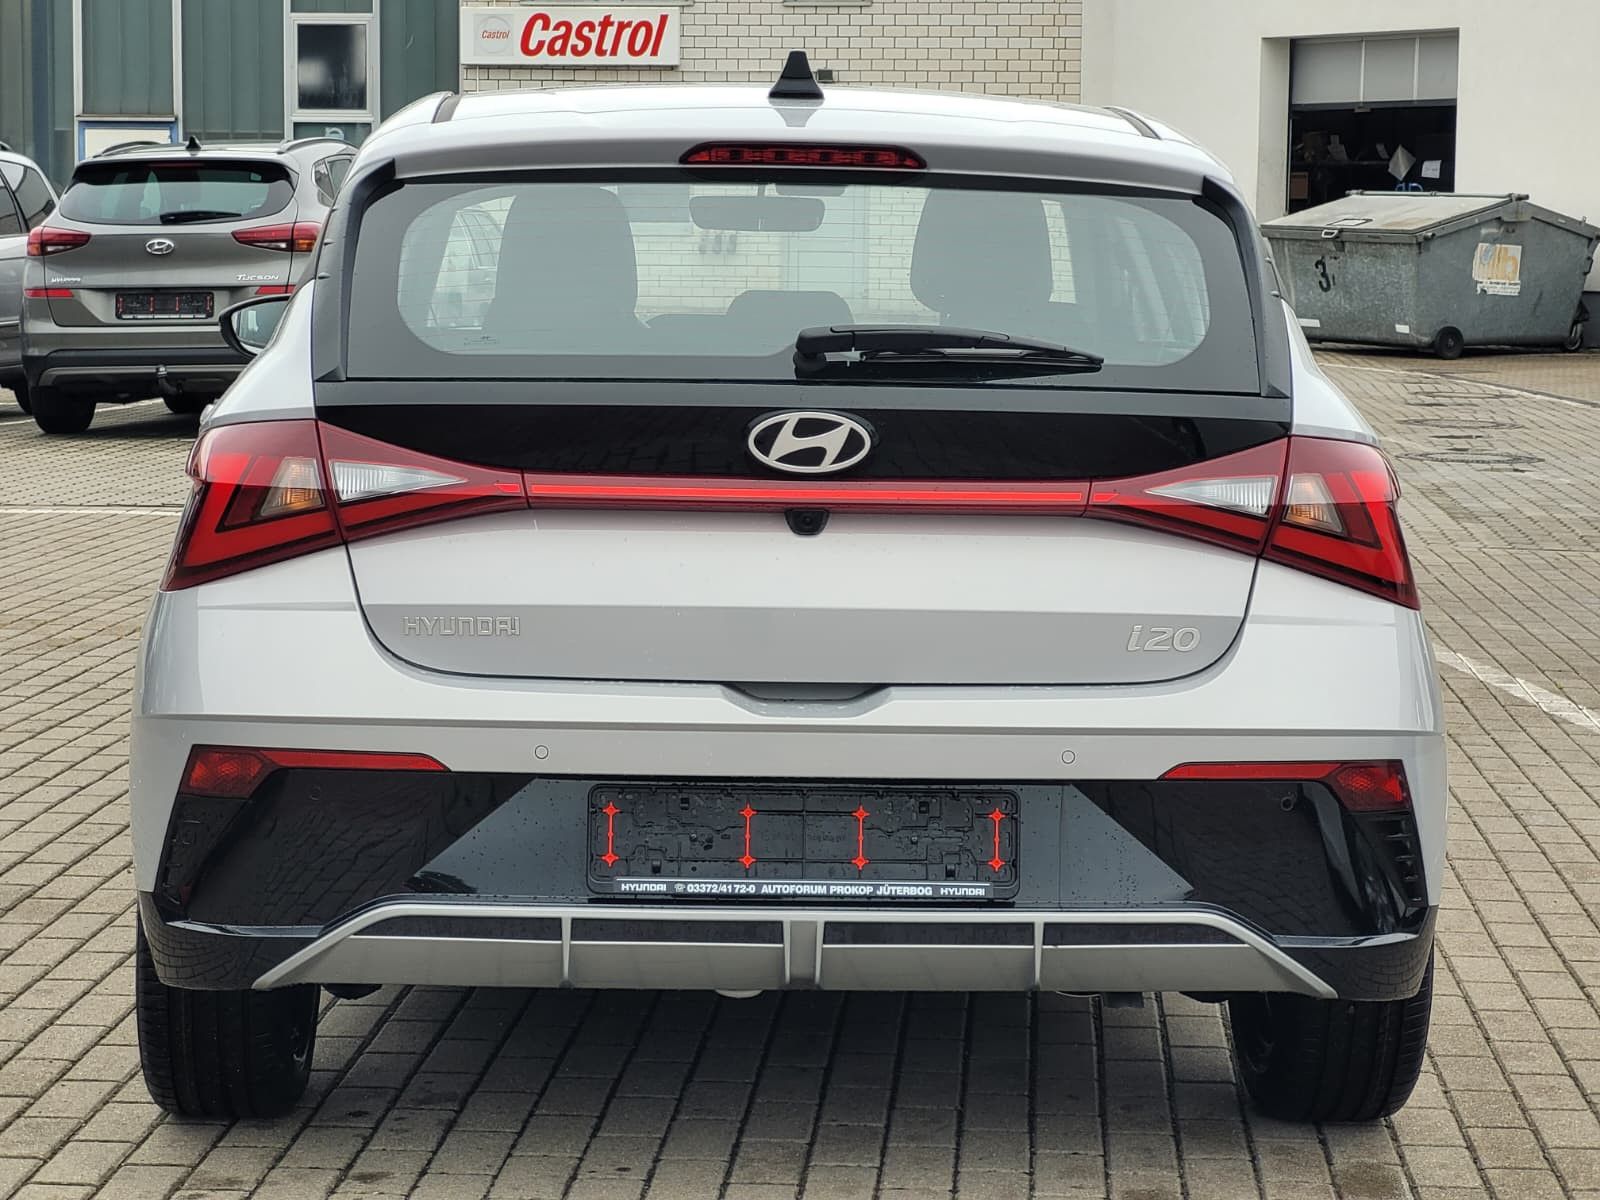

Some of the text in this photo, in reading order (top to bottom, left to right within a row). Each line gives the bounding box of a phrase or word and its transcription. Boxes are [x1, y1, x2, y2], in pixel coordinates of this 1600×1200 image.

[481, 29, 510, 40] Castrol
[520, 12, 669, 57] Castrol
[402, 615, 521, 637] HYUNDAI
[1126, 624, 1201, 653] i20
[621, 883, 985, 896] HYUNDAI 03372/4172-0 AUTOFORUM PROKOP JÜTERBOG HYUNDAI
